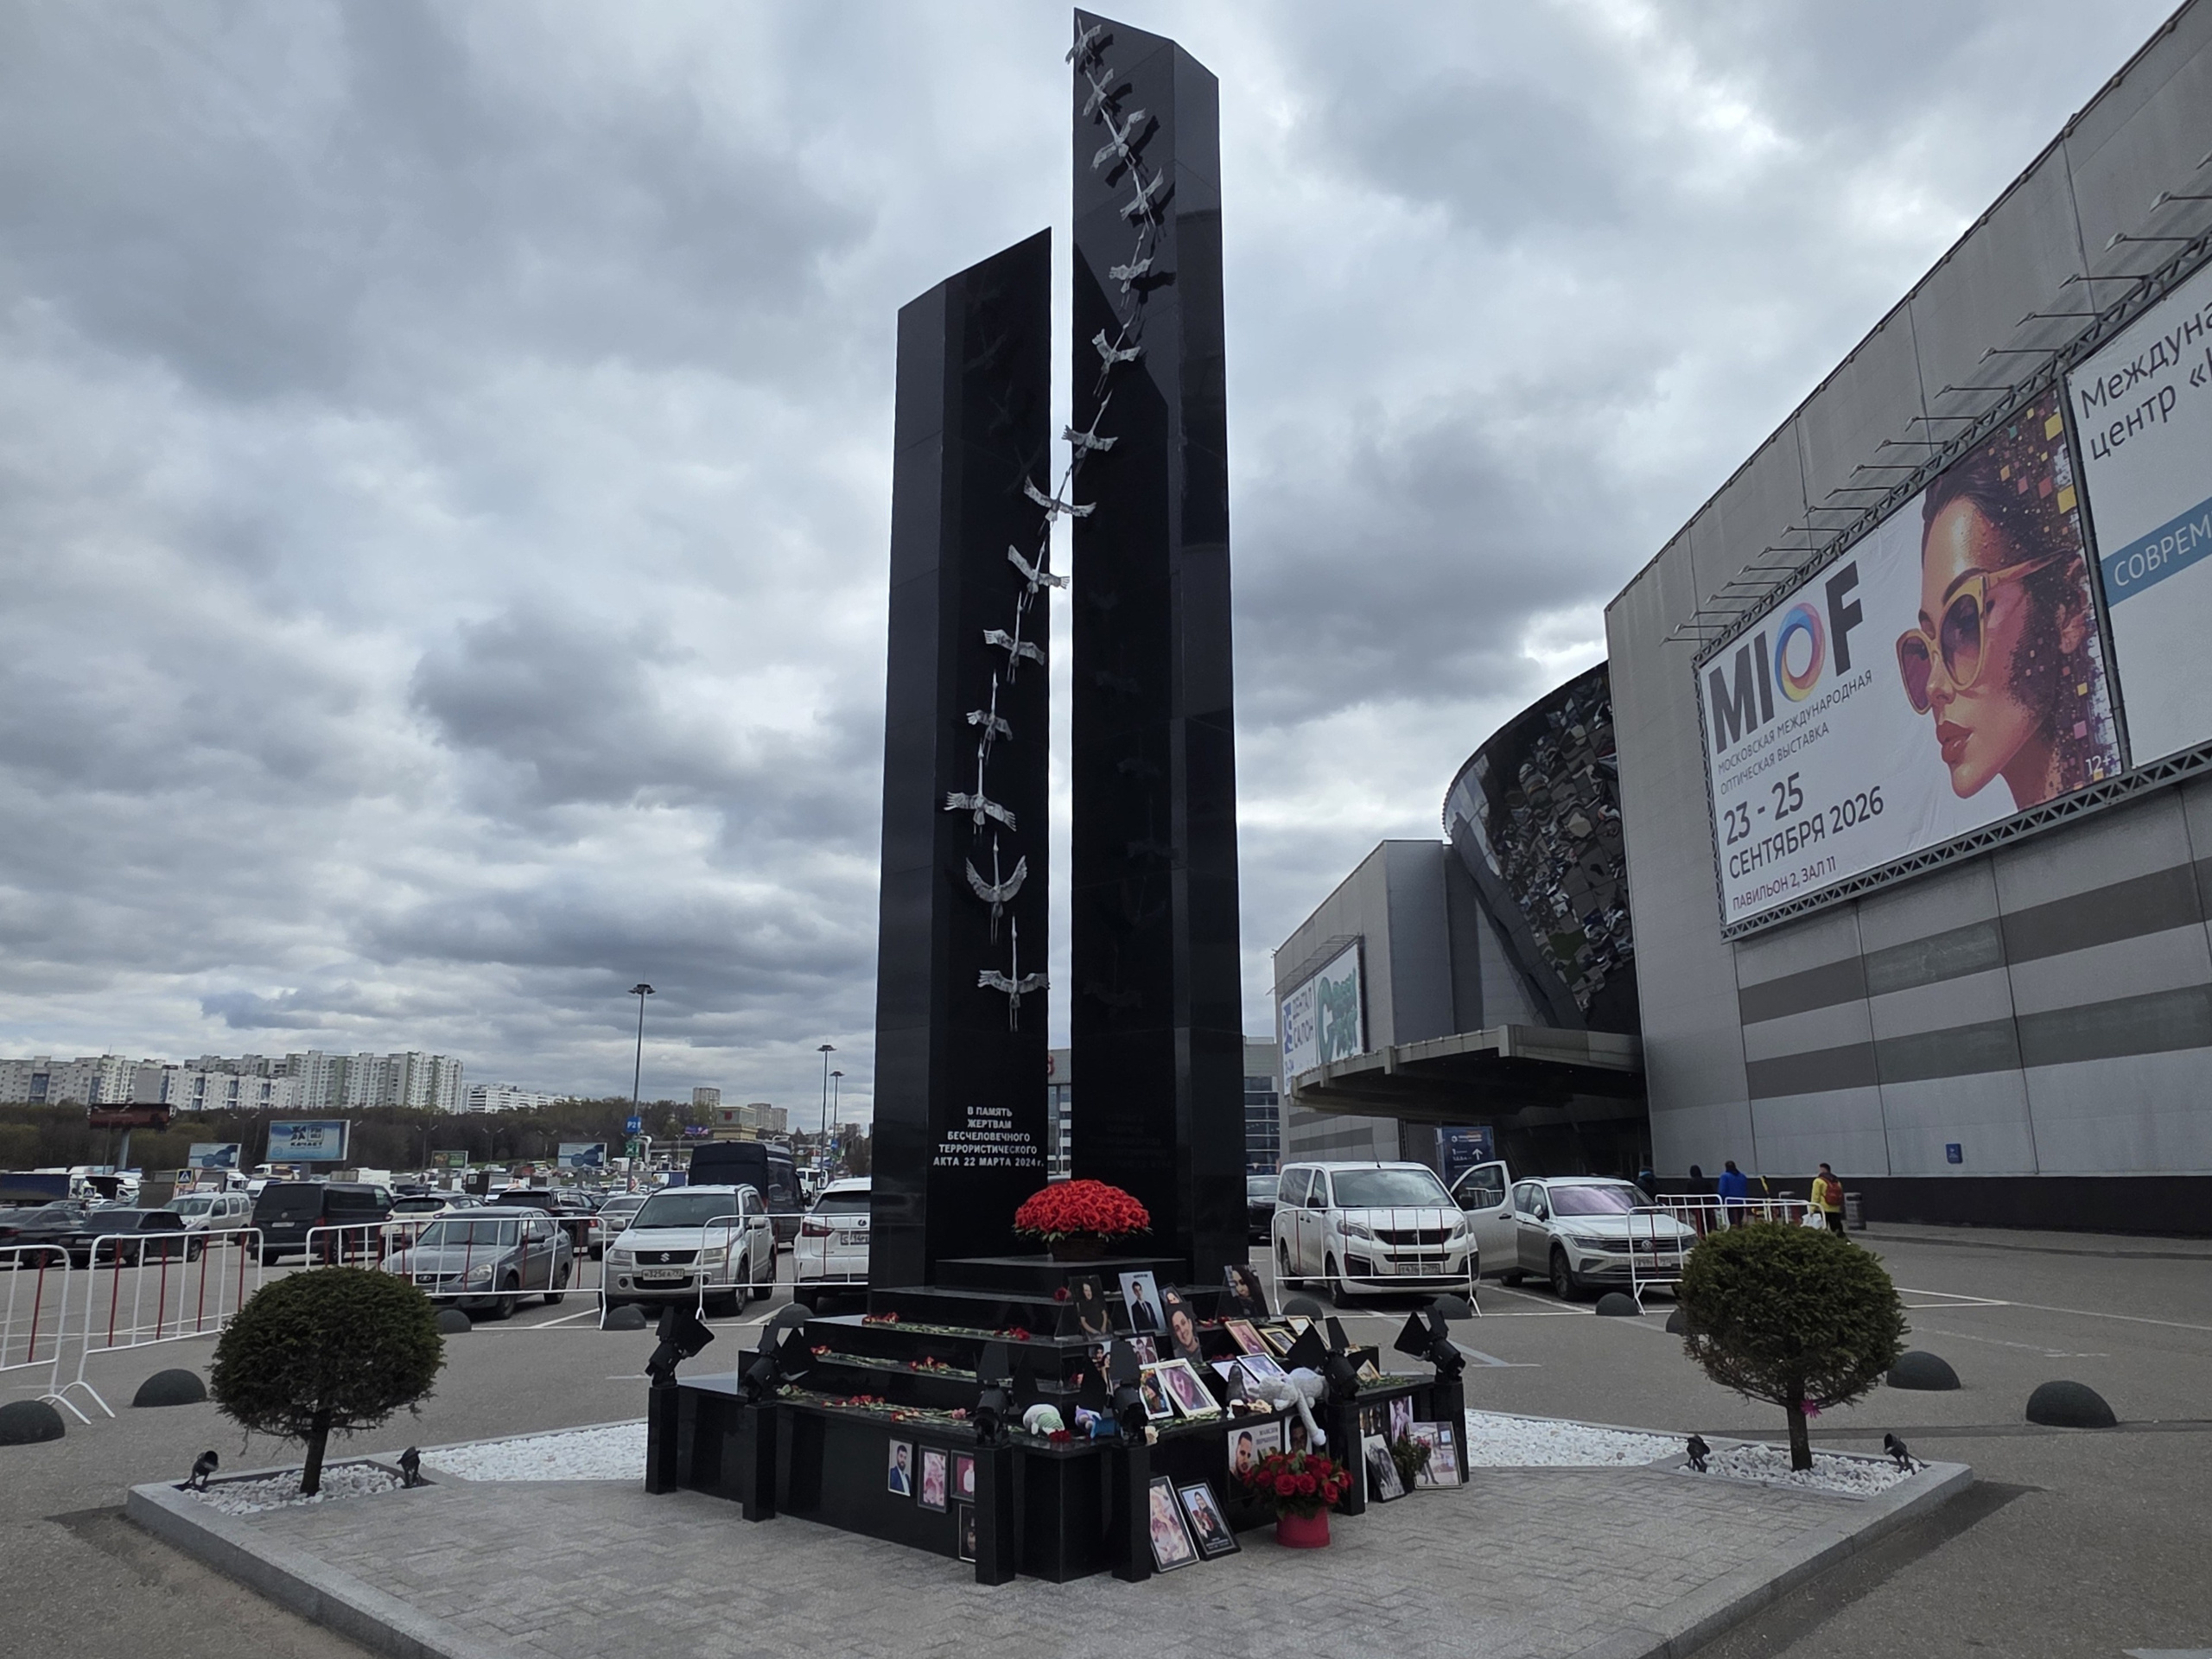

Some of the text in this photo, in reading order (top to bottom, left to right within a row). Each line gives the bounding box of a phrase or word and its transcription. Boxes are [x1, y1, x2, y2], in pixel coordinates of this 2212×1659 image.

[2091, 385, 2176, 460] центр
[1708, 560, 1863, 755] MIOF
[1718, 670, 1872, 775] МОСКОВСКАЯ МЕЖДУНАРОДНАЯ
[1720, 721, 1829, 795] ОПТИЧЕСКАЯ ВЫСТАВКА
[2085, 755, 2111, 776] 12+
[1724, 801, 1751, 846] 23
[1771, 772, 1803, 820] 25
[1729, 785, 1884, 879] СЕНТЯБРЯ 2026
[1732, 855, 1836, 910] ПАВИЛЬОН 2, ЗАЛ 11
[947, 1131, 1030, 1141] БЕСЧЕЛОВЕЧНОГО
[967, 1106, 1013, 1117] В ПАМЯТЬ
[967, 1119, 1012, 1128] ЖЕРТВАМ
[933, 1157, 959, 1166] АКТА
[963, 1157, 976, 1166] 22
[978, 1157, 1012, 1166] МАРТА
[1014, 1158, 1036, 1166] 2024
[938, 1144, 1037, 1154] ТЕРРОРИСТИЧЕСКОГО
